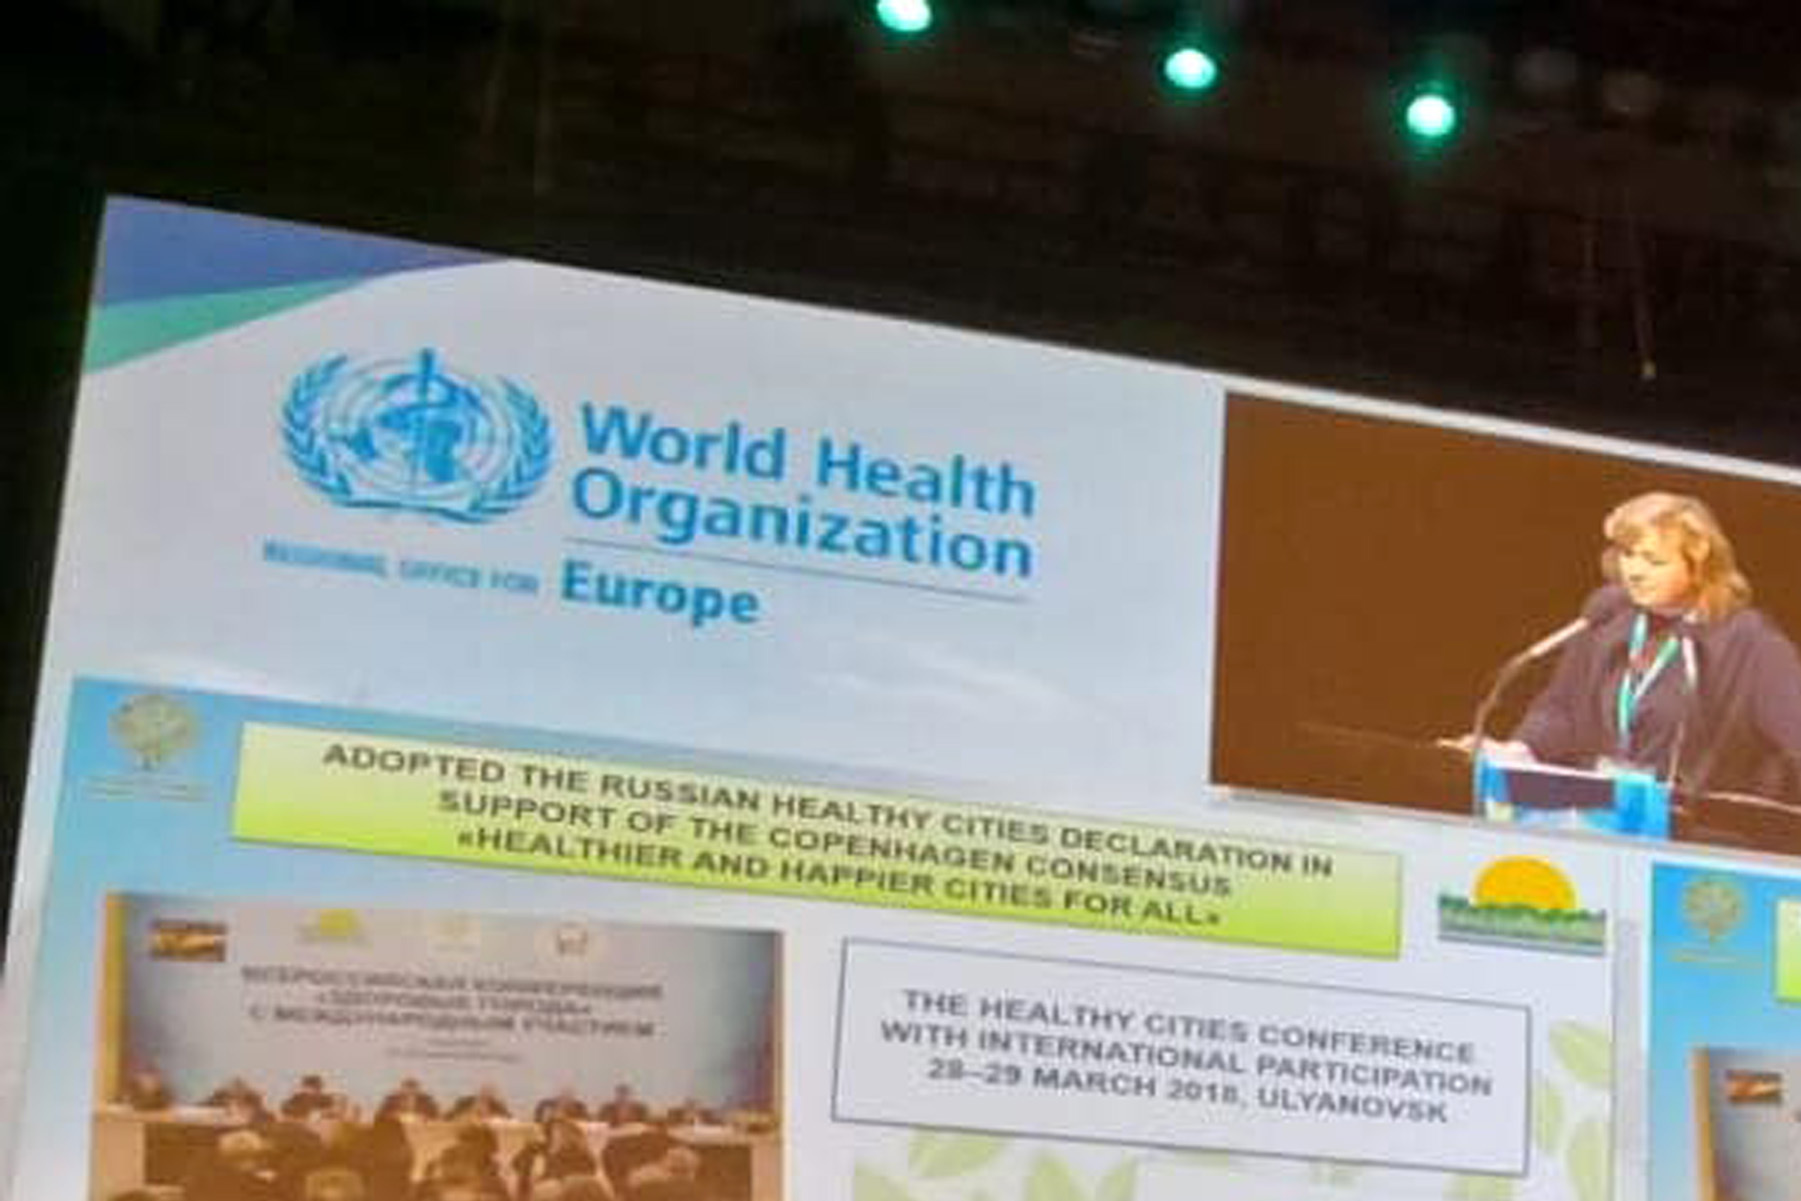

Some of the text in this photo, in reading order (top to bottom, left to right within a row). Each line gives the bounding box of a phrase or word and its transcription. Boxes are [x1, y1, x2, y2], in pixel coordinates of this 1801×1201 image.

[582, 402, 1034, 517] World Health
[572, 467, 1032, 578] Organization
[489, 568, 541, 598] FOR
[562, 560, 760, 627] Europe
[322, 743, 1334, 877] ADOPTED THE RUSSIAN HEALTHY CITIES DECLARATION IN
[438, 790, 1232, 898] SUPPORT OF THE COPENHAGEN CONSENSUS
[692, 850, 769, 880] AND
[780, 857, 935, 896] HAPPIER
[943, 877, 1053, 910] CITIES
[1063, 889, 1133, 918] FOR
[879, 1020, 1493, 1097] WITH INTERNATIONAL PARTICIPATION
[902, 988, 1477, 1064] THE HEALTHY CITIES CONFERENCE
[1032, 1066, 1157, 1097] MARCH
[1257, 1086, 1448, 1124] ULYANOVSK
